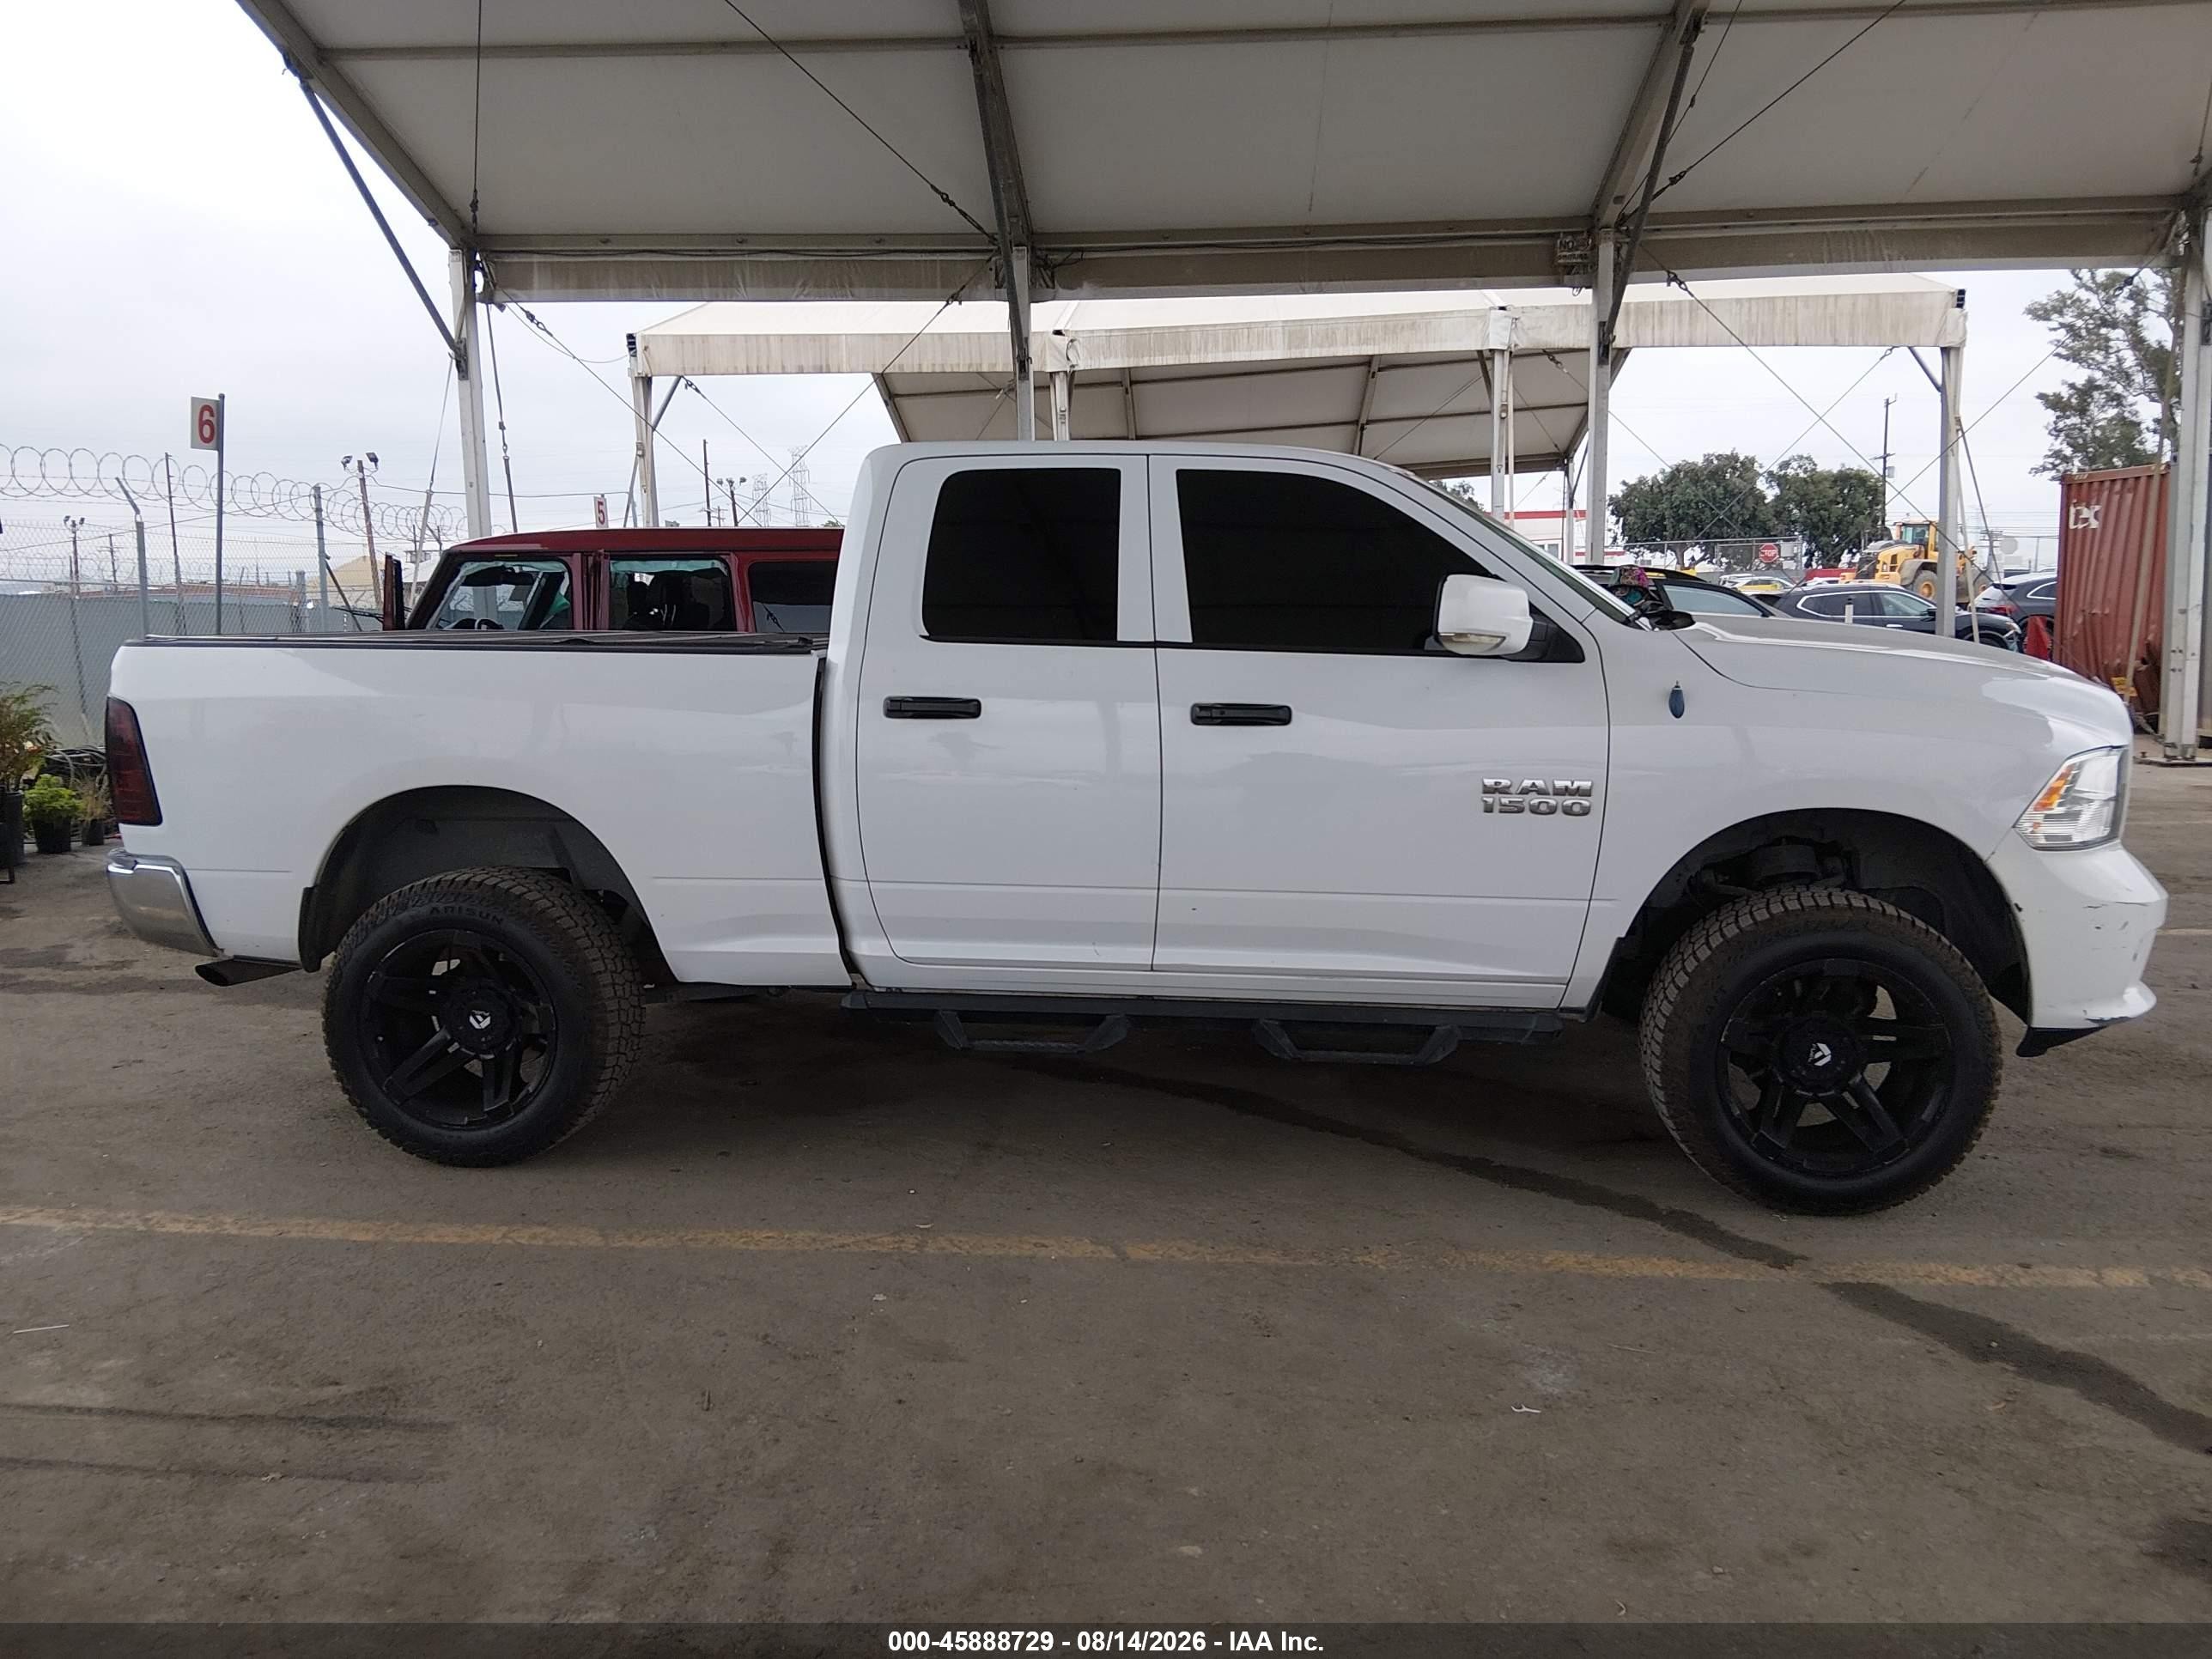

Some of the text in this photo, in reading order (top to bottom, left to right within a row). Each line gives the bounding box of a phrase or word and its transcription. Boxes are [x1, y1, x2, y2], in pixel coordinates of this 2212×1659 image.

[198, 404, 215, 444] 6
[597, 500, 605, 525] 5
[1481, 778, 1593, 797] RAM
[1481, 797, 1591, 816] 1500
[429, 906, 504, 925] ARISUN
